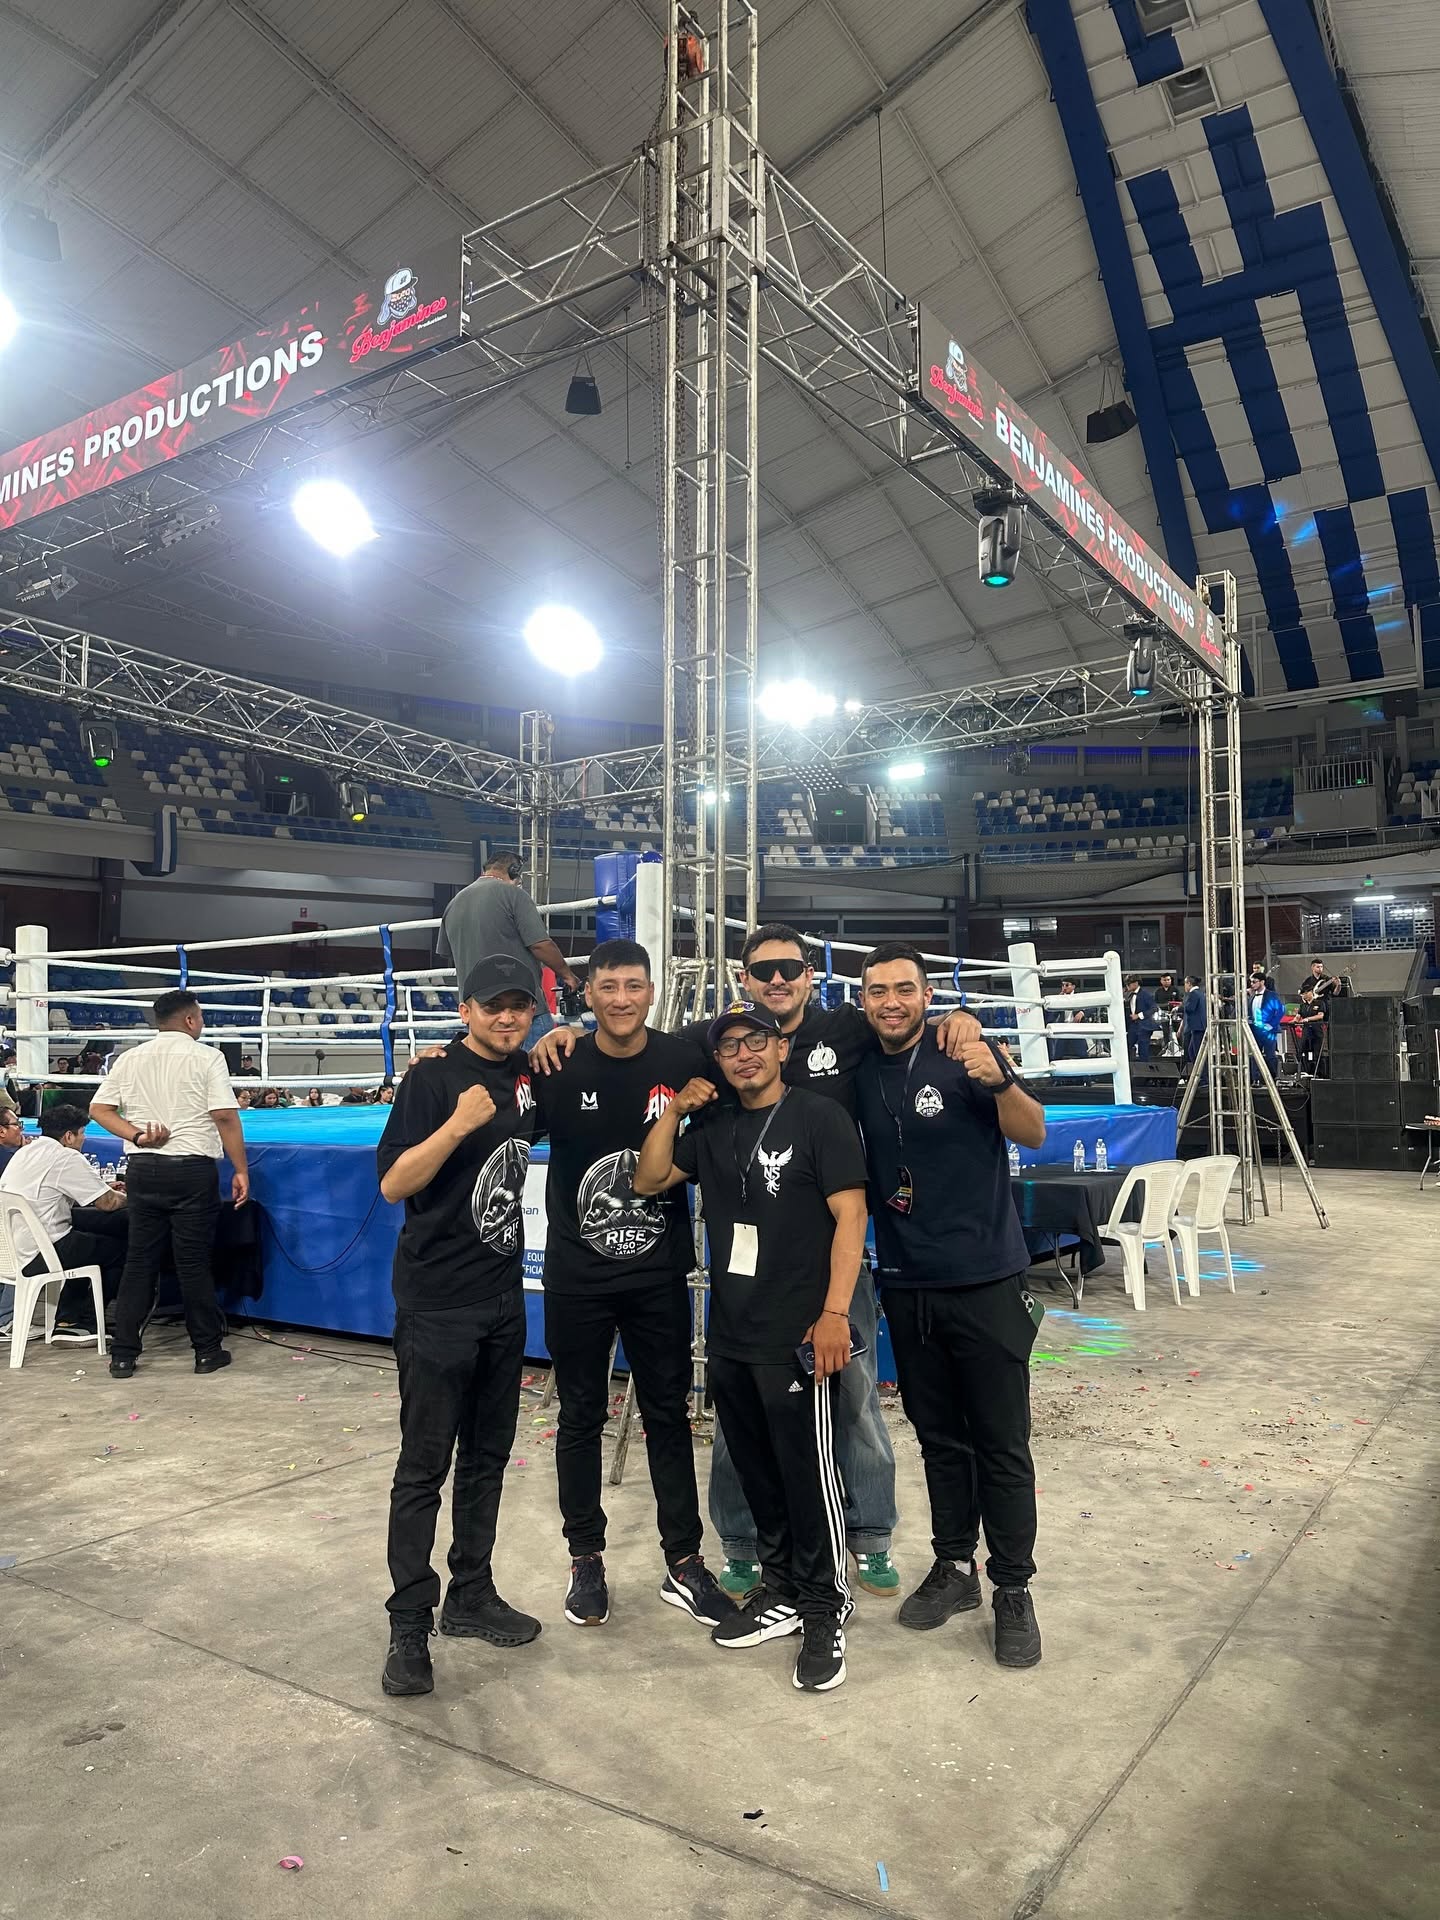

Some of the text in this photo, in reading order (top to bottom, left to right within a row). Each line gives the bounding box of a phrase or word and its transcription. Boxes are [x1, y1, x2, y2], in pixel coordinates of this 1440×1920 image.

[349, 296, 448, 363] Benjamines
[83, 330, 324, 467] PRODUCTIONS
[995, 407, 1195, 628] BENJAMINES PRODUCTIONS
[605, 1229, 646, 1246] RISE
[616, 1241, 636, 1250] 360
